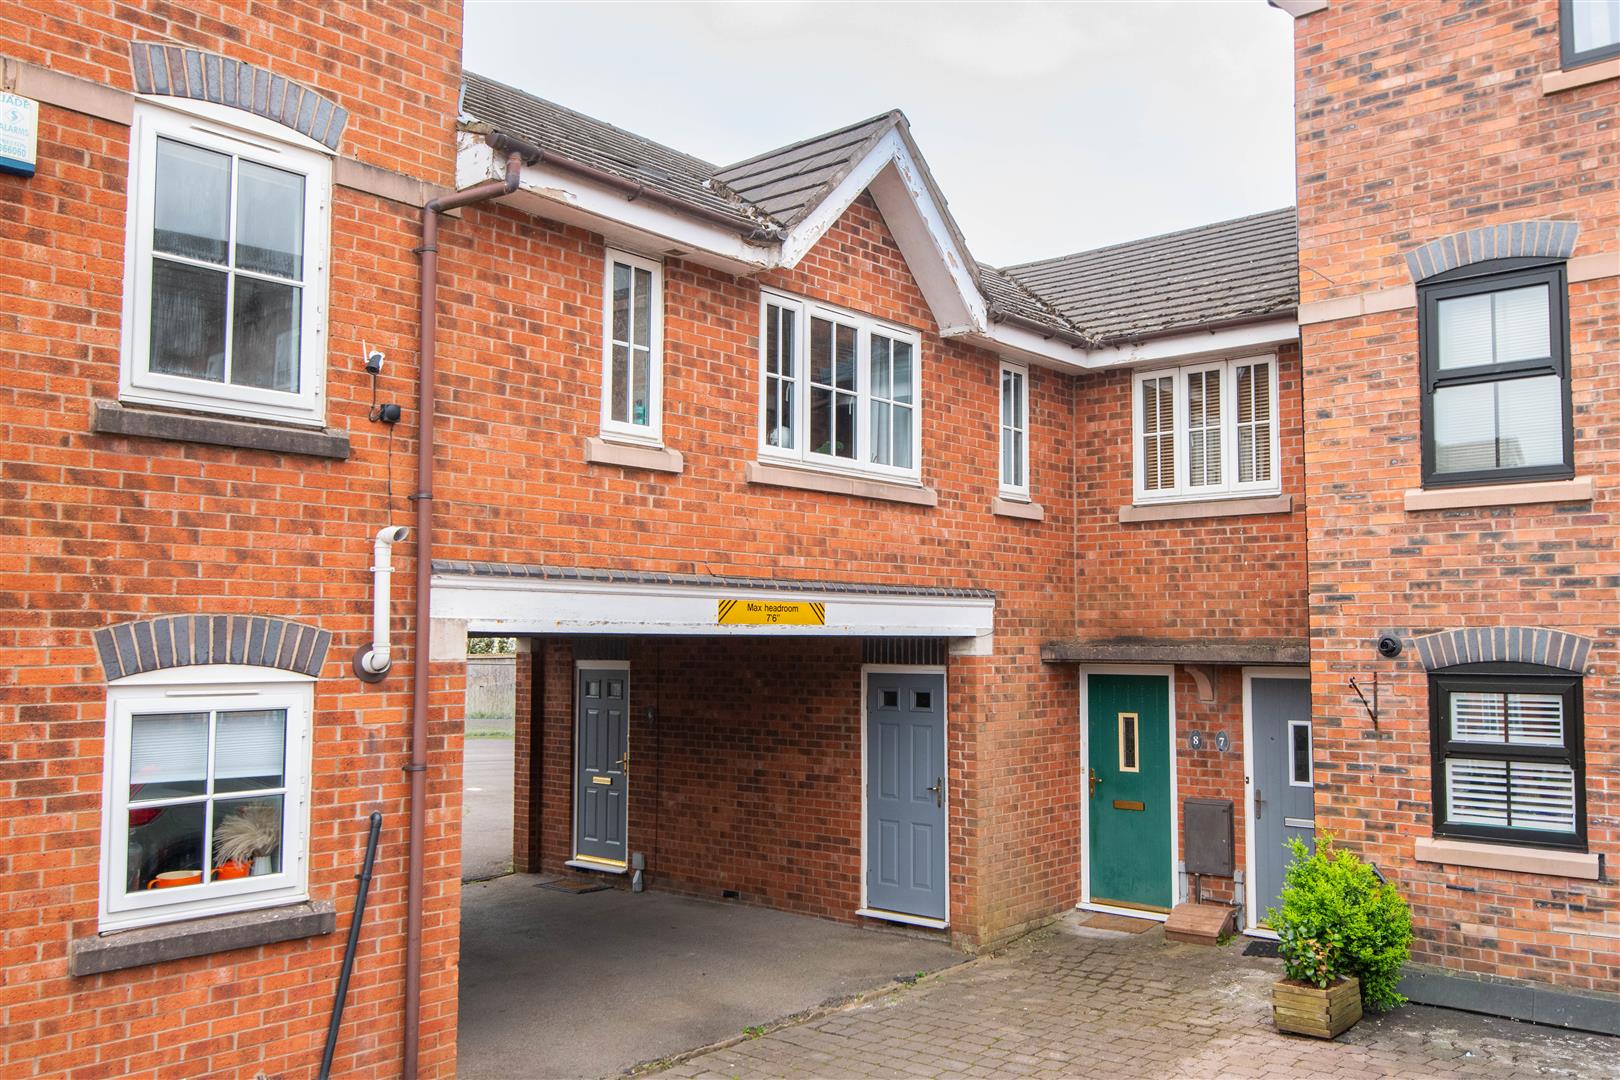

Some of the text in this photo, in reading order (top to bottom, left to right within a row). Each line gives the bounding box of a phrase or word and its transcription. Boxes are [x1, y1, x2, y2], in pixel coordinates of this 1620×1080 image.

[747, 603, 799, 613] Max headroom
[1193, 735, 1199, 745] 8
[1218, 737, 1225, 746] 7
